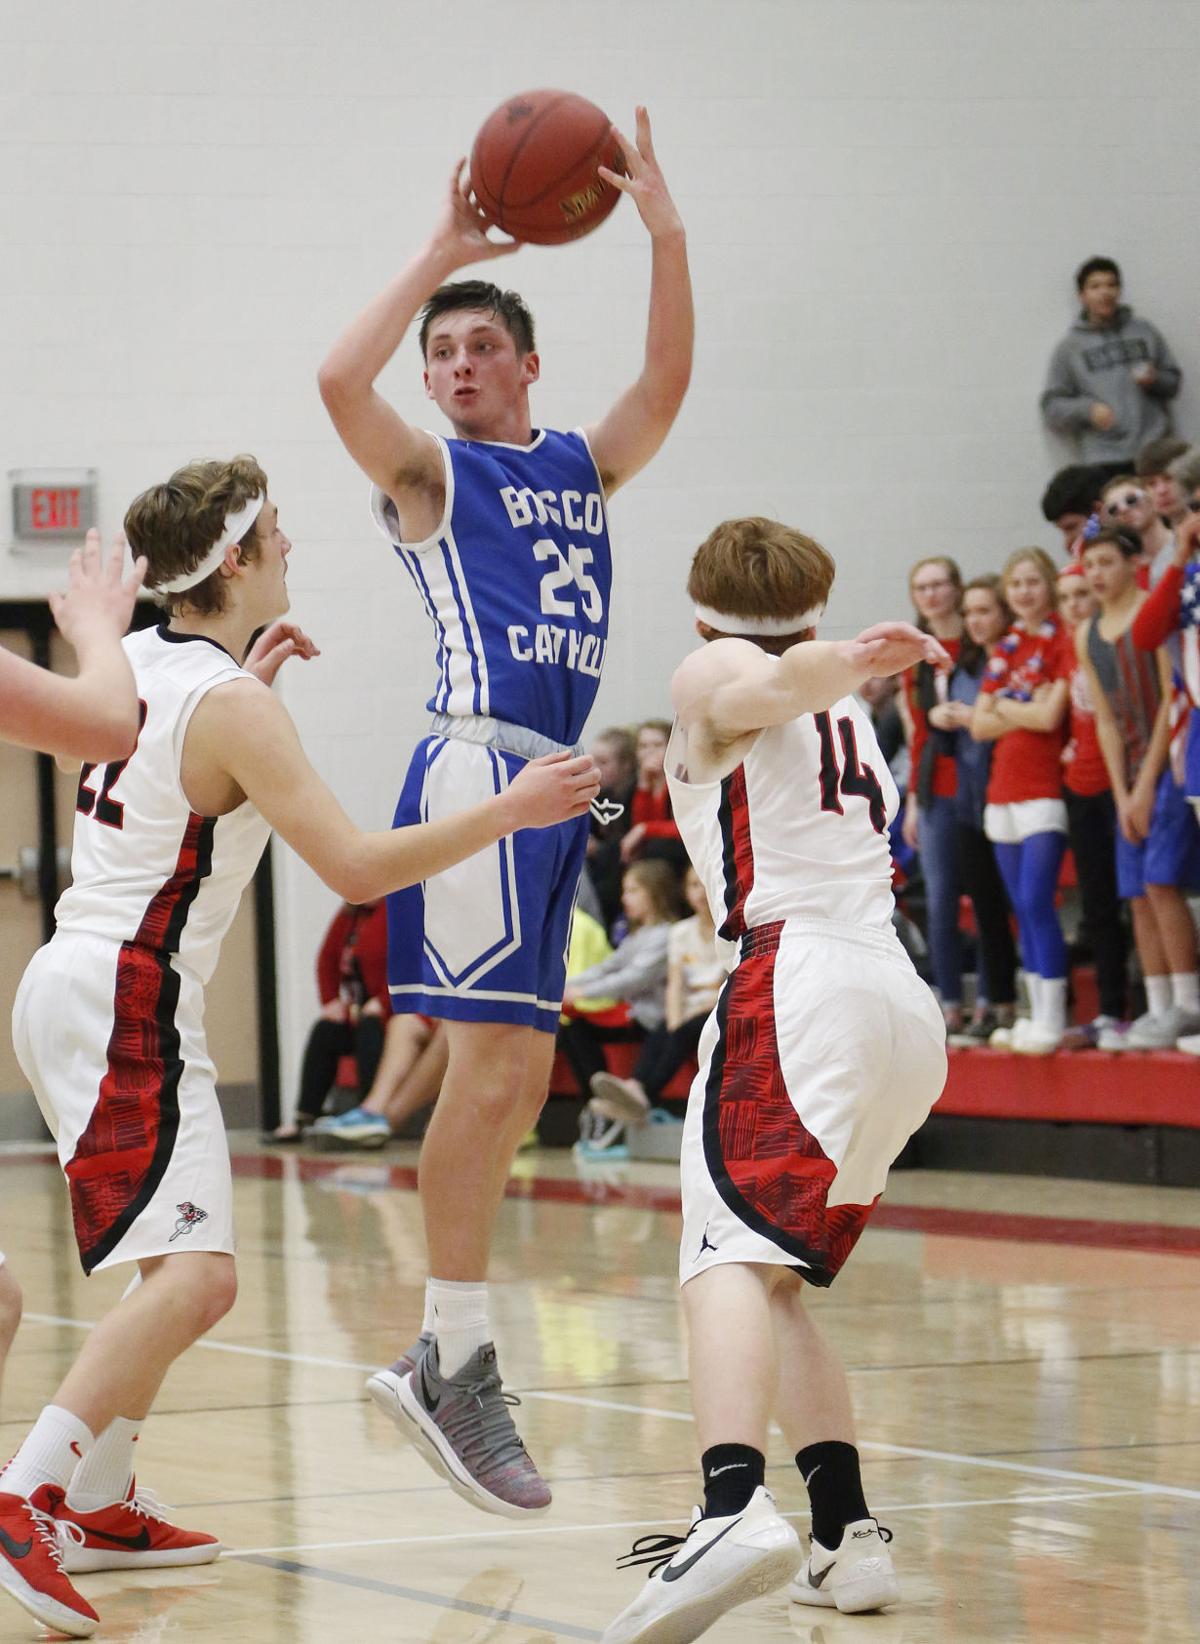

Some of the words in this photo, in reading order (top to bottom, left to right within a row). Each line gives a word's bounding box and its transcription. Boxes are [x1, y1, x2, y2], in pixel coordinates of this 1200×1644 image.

[31, 487, 80, 529] EXIT
[500, 485, 603, 535] BOSCO
[532, 538, 603, 623] 25
[813, 709, 887, 836] 14
